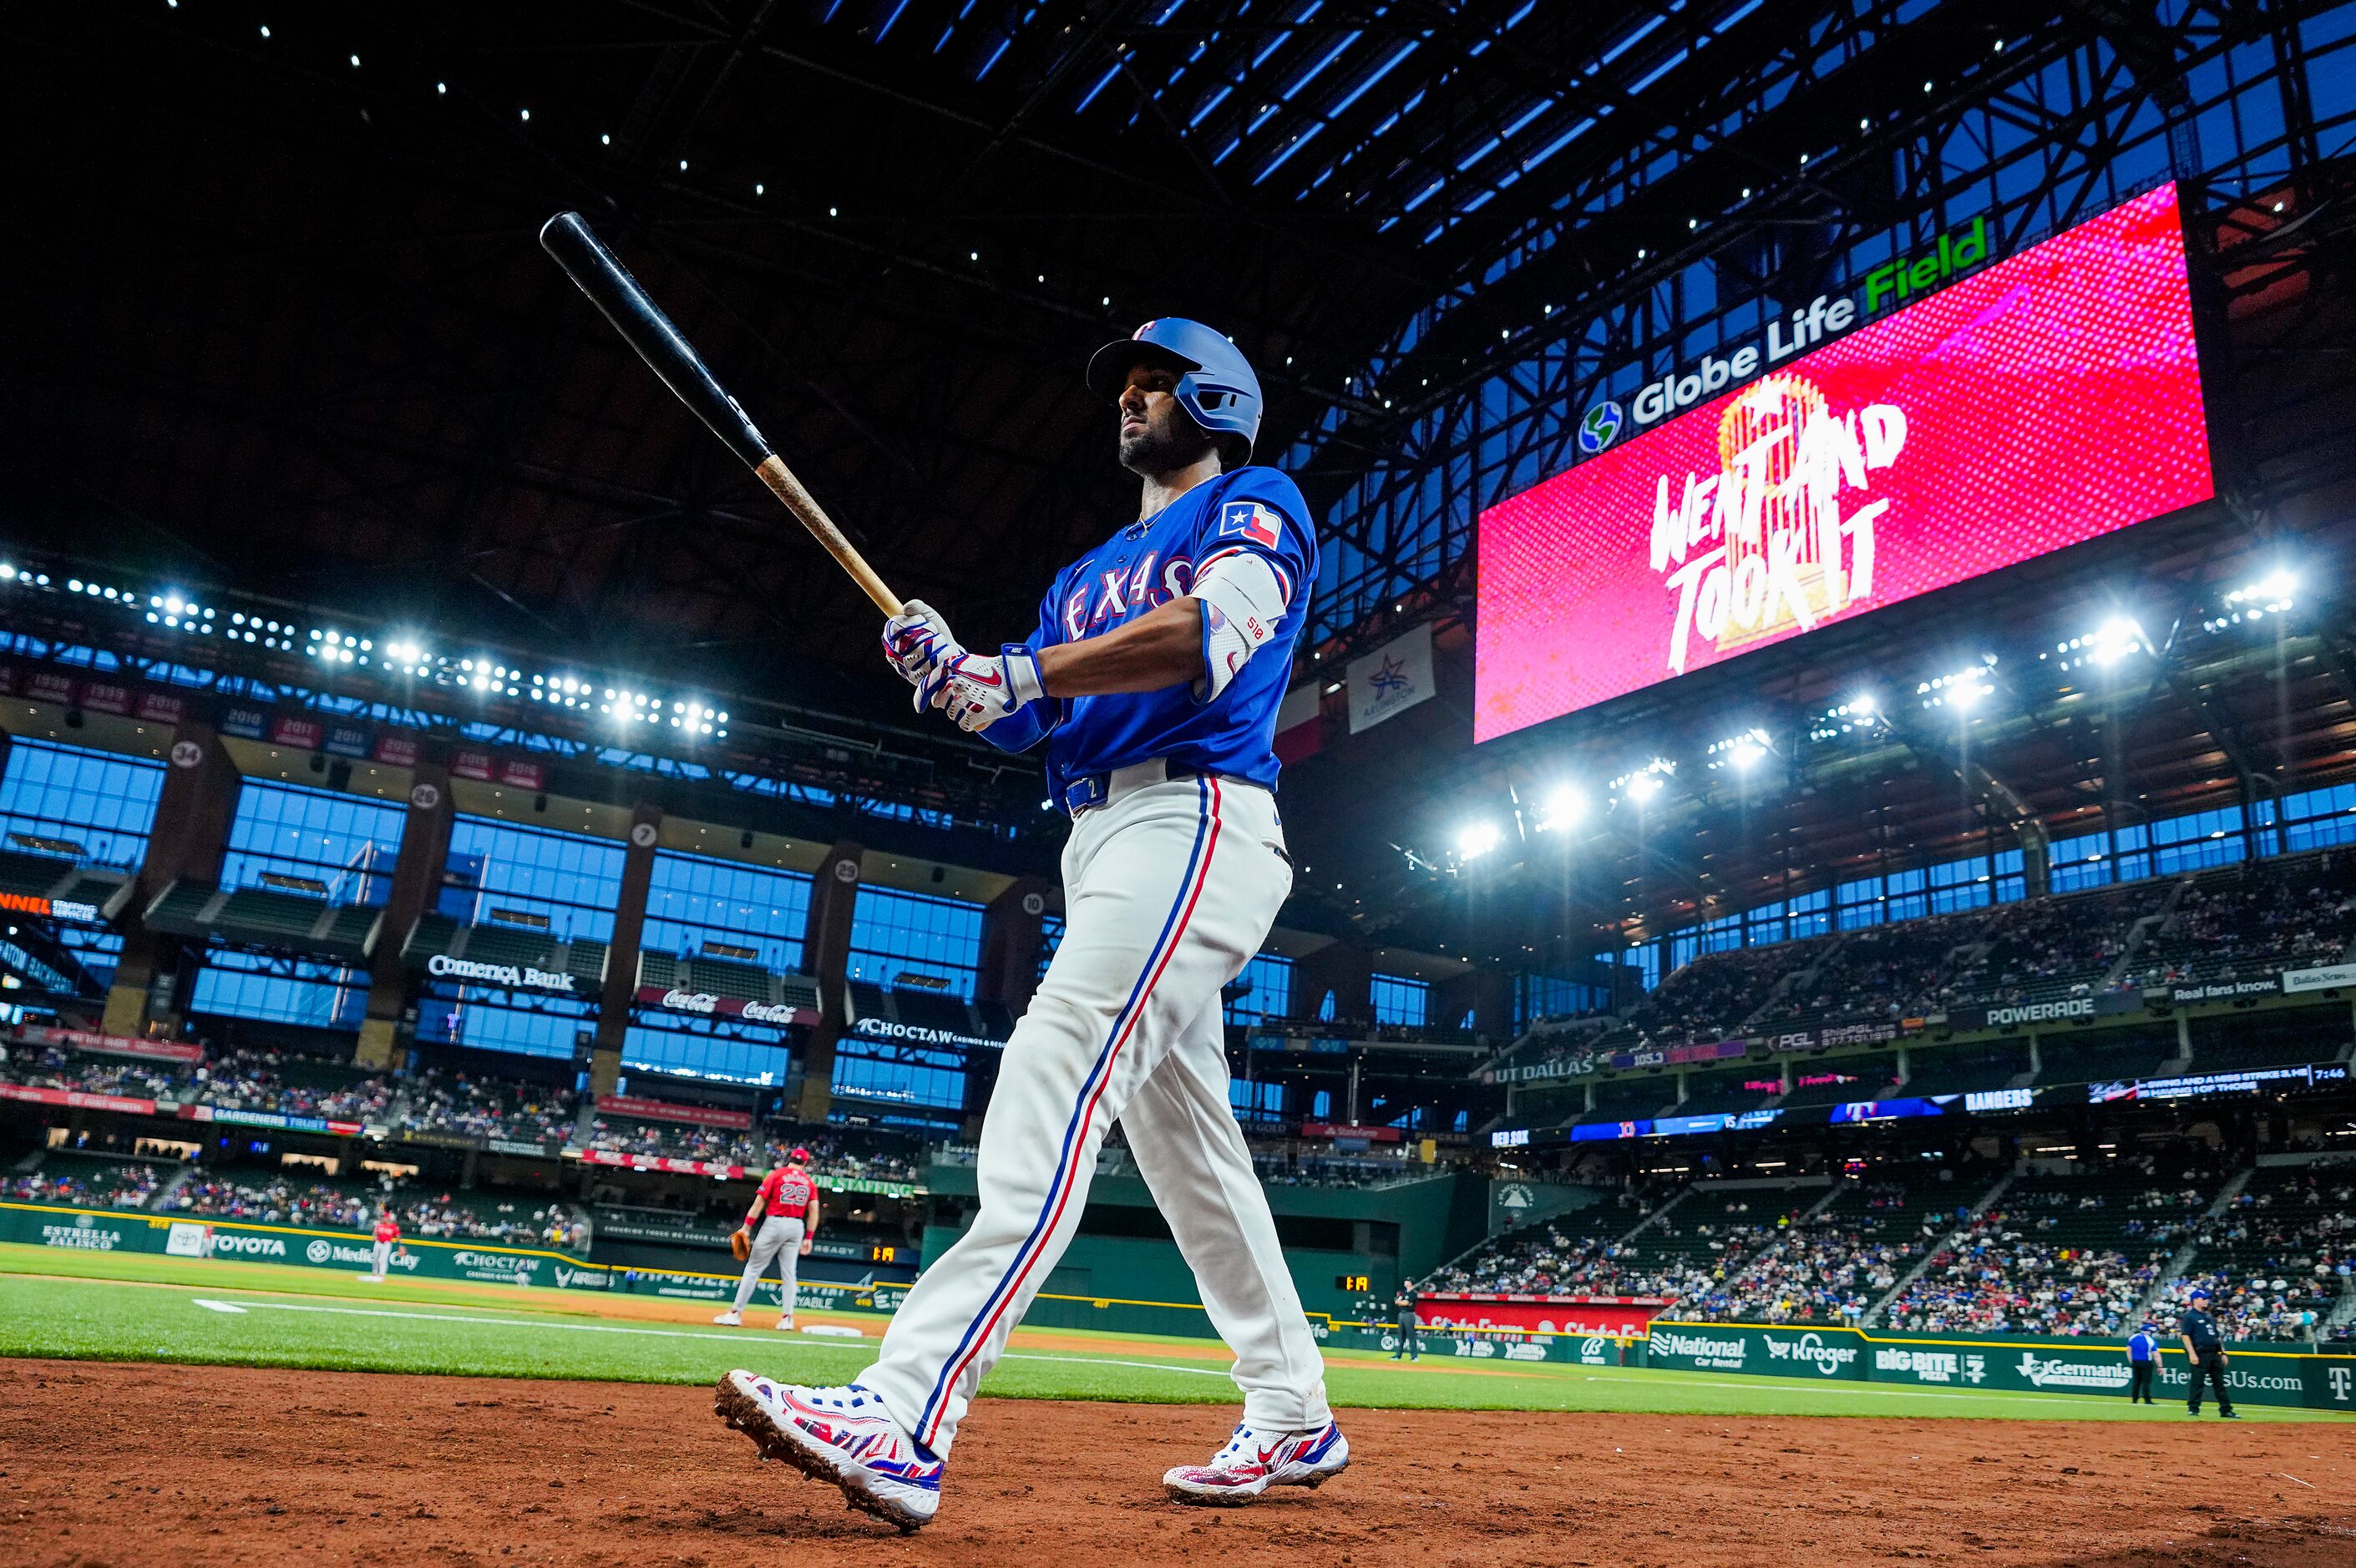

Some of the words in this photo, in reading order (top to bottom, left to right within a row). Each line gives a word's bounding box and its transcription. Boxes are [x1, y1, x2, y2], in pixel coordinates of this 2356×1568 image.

[1633, 345, 1758, 425] Globe
[1767, 295, 1855, 364] Life
[1865, 215, 1989, 314] Field
[1649, 423, 1794, 574] WENT
[1769, 403, 1908, 513] AND
[1063, 549, 1194, 645] EXAS
[1664, 528, 1817, 676] TOOK
[1246, 616, 1264, 640] 510
[1011, 646, 1023, 655] NIKE
[1088, 780, 1097, 798] 2
[0, 893, 51, 915] NNEL
[523, 967, 576, 991] Bank
[2174, 989, 2202, 1002] Real
[2206, 984, 2235, 999] fans
[1987, 998, 2095, 1026] POWERADE
[867, 1018, 955, 1044] CHOCTAW
[1778, 1031, 1815, 1049] PGL
[1634, 1052, 1664, 1066] 105.3
[1495, 1068, 1517, 1084] UT
[1523, 1059, 1595, 1080] DALLAS
[2181, 1076, 2206, 1087] AND
[2242, 1070, 2280, 1081] STRIKE
[2313, 1068, 2346, 1080] 7:46
[1964, 1088, 2034, 1111] RANGERS
[2199, 1085, 2217, 1094] OF
[1492, 1130, 1510, 1146] RED
[1510, 1129, 1529, 1145] SOX
[837, 1177, 915, 1198] STAFFING
[42, 1225, 121, 1243] ESTRELLA
[46, 1235, 114, 1251] JALISCO
[210, 1233, 287, 1257] TOYOTA
[332, 1245, 374, 1263] Medic
[797, 1296, 834, 1310] YABLE
[1310, 1323, 1330, 1339] ife
[1695, 1356, 1711, 1368] Car
[1712, 1357, 1743, 1368] Rental
[1791, 1333, 1858, 1375] Kroger
[1912, 1352, 1960, 1373] BITE
[1918, 1370, 1951, 1382] PIZZA
[2047, 1358, 2133, 1379] Germania
[2162, 1366, 2303, 1392] HeesUs.com
